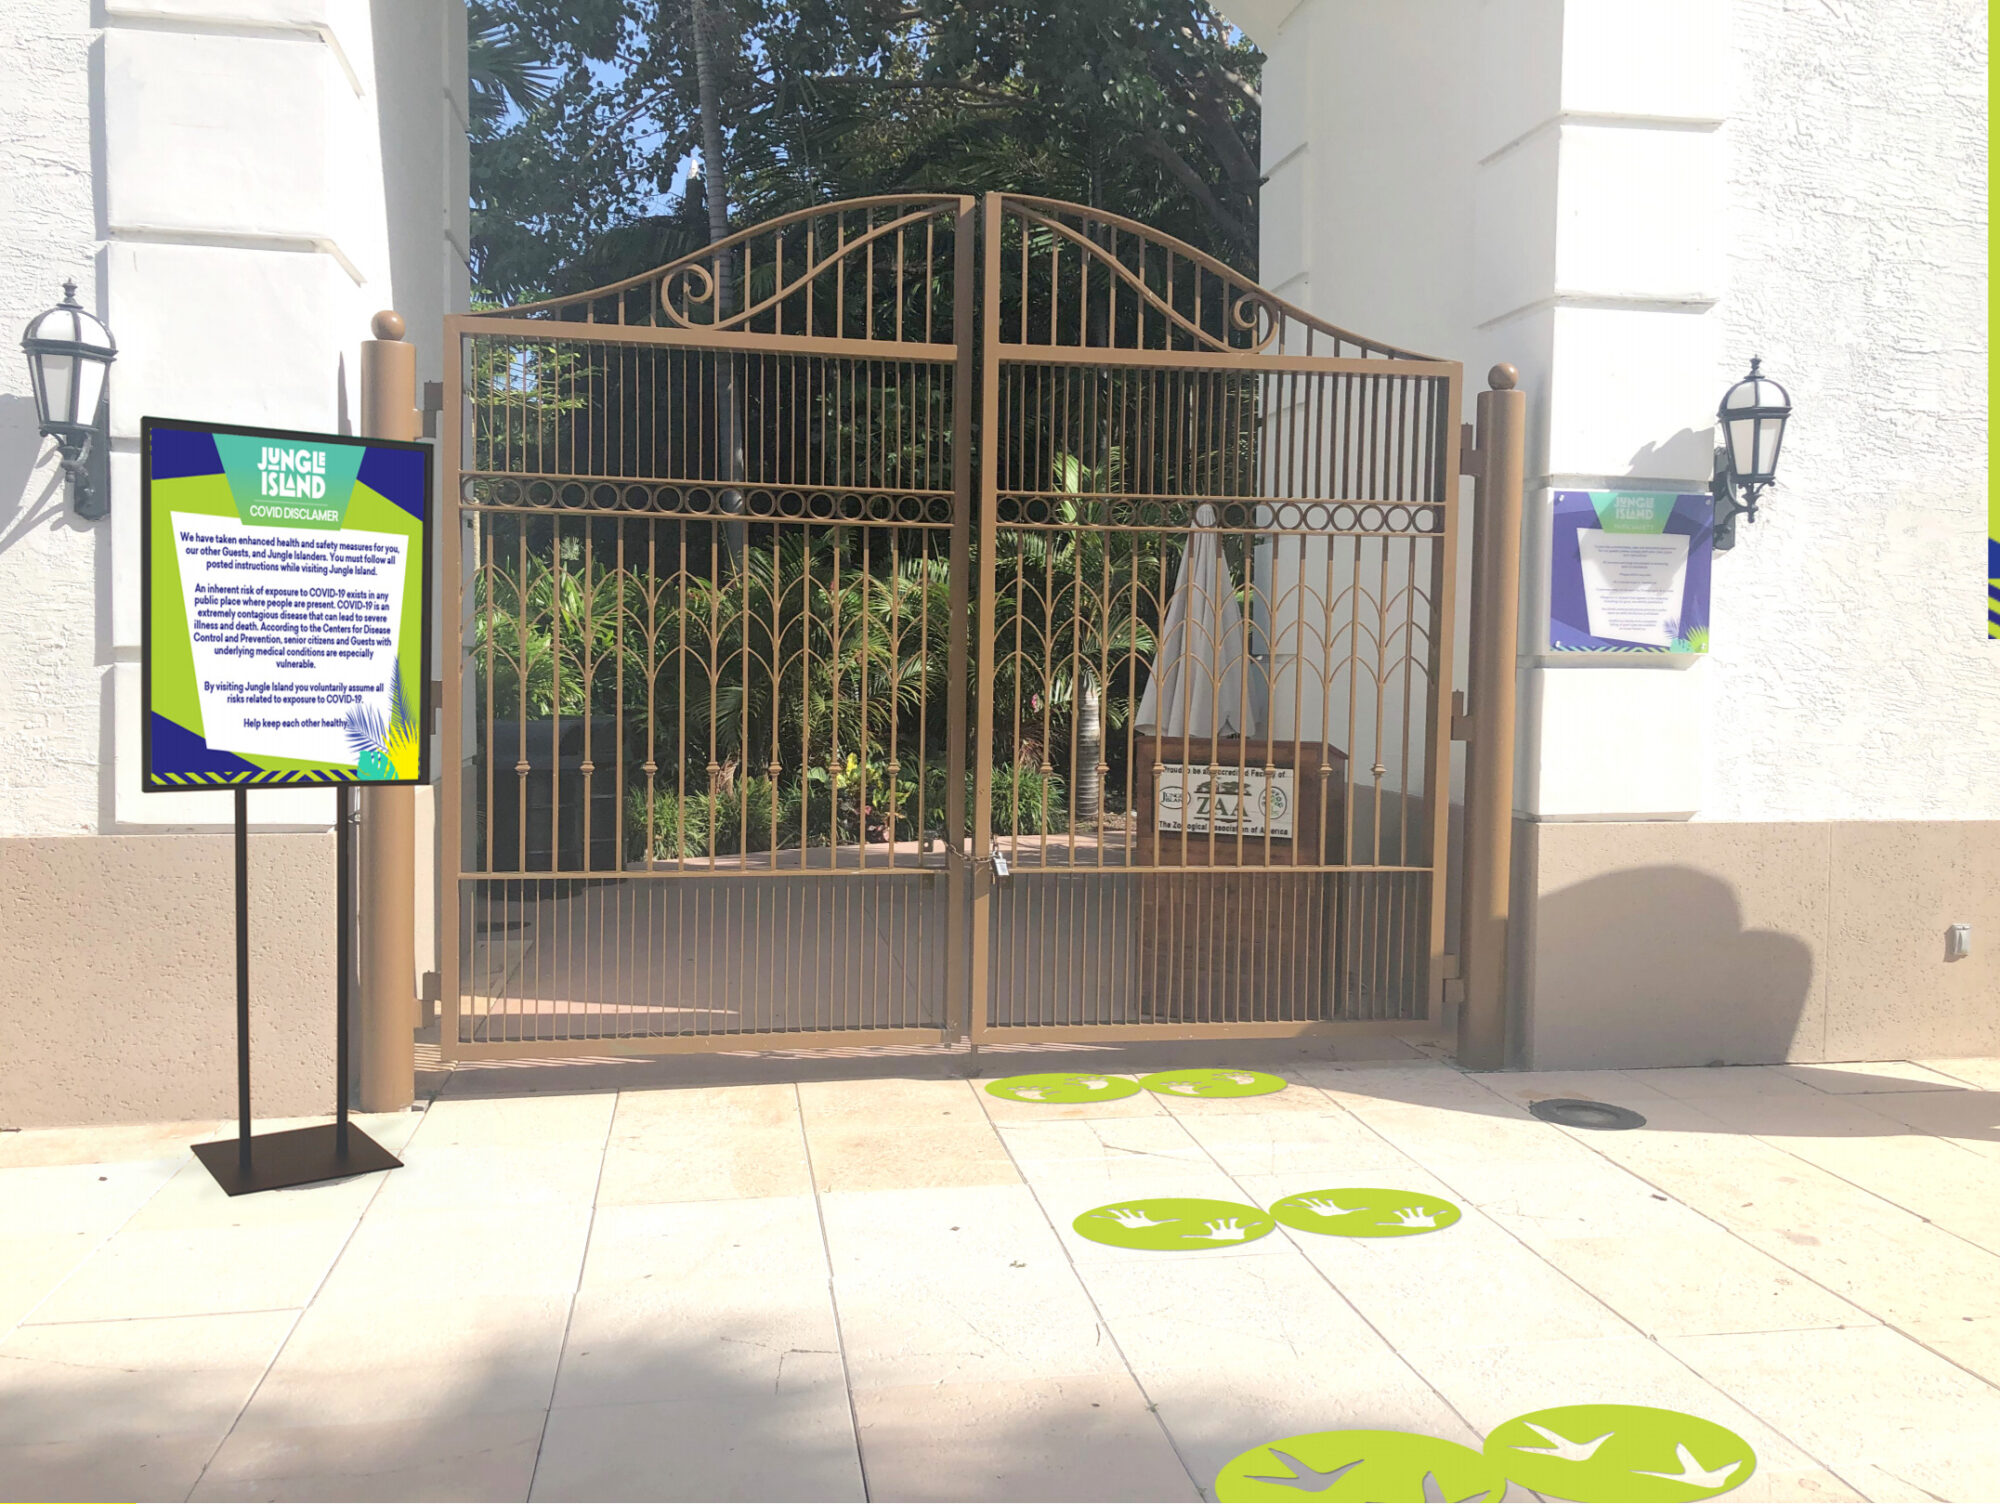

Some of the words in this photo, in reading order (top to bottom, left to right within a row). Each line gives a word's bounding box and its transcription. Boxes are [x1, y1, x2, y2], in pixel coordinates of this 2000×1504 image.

[257, 446, 326, 474] JUNGLE
[261, 471, 326, 499] ISLAND
[249, 505, 283, 518] COVID
[283, 507, 339, 521] DISCLAMER
[1616, 508, 1654, 520] ISLAND
[180, 532, 194, 542] We
[195, 533, 214, 543] have
[214, 534, 237, 544] taken
[238, 536, 275, 546] enhanced
[276, 537, 300, 547] health
[300, 539, 314, 548] and
[315, 540, 338, 552] safety
[373, 543, 384, 552] for
[384, 546, 400, 555] you,
[199, 546, 221, 555] other
[221, 547, 250, 558] Guests,
[251, 549, 266, 558] and
[267, 549, 293, 562] Jungle
[293, 551, 328, 561] Islanders.
[329, 551, 344, 562] You
[344, 555, 363, 563] must
[363, 554, 386, 564] follow
[386, 553, 395, 564] all
[205, 560, 233, 570] posted
[234, 560, 279, 571] instructions
[279, 561, 300, 572] while
[301, 563, 328, 576] visiting
[328, 565, 353, 577] Jungle
[354, 566, 378, 575] Island.
[194, 583, 206, 592] An
[207, 584, 239, 594] inherent
[240, 585, 254, 594] risk
[255, 586, 264, 595] of
[264, 589, 299, 600] exposure
[299, 589, 308, 597] to
[308, 588, 345, 598] COVID-19
[346, 590, 367, 599] exists
[368, 590, 375, 599] in
[376, 593, 388, 602] any
[194, 595, 218, 607] public
[219, 596, 241, 610] place
[242, 597, 265, 606] where
[266, 597, 292, 611] people
[306, 601, 335, 612] present.
[336, 600, 373, 610] COVID-19
[373, 602, 380, 610] is
[197, 609, 236, 622] extremely
[236, 608, 278, 623] contagious
[279, 610, 307, 620] disease
[308, 611, 323, 620] that
[338, 612, 354, 621] lead
[354, 614, 363, 622] to
[193, 620, 218, 630] illness
[219, 620, 234, 630] and
[235, 621, 258, 630] death.
[260, 622, 299, 635] According
[299, 624, 308, 632] to
[309, 624, 321, 632] the
[322, 624, 351, 633] Centers
[351, 624, 362, 633] for
[363, 625, 391, 634] Disease
[193, 632, 223, 642] Control
[224, 634, 239, 642] and
[239, 633, 282, 644] Prevention,
[283, 634, 306, 644] senior
[307, 636, 335, 645] citizens
[335, 637, 349, 645] and
[350, 636, 375, 646] Guests
[375, 637, 391, 646] with
[214, 646, 255, 658] underlying
[255, 647, 285, 656] medical
[286, 647, 325, 656] conditions
[338, 649, 374, 660] especially
[275, 659, 316, 668] vulnerable.
[203, 681, 214, 693] By
[215, 681, 244, 694] visiting
[244, 682, 270, 694] Jungle
[271, 682, 294, 691] Island
[294, 685, 308, 694] you
[309, 683, 347, 695] voluntarily
[375, 683, 384, 692] all
[226, 693, 244, 703] risks
[245, 693, 272, 703] related
[273, 695, 282, 703] to
[282, 697, 316, 706] exposure
[243, 718, 261, 730] Help
[262, 718, 281, 730] keep
[281, 719, 299, 727] each
[300, 718, 320, 727] other
[1196, 797, 1248, 817] ZAA
[1159, 820, 1171, 828] The
[1250, 826, 1258, 834] of
[1260, 826, 1288, 836] Aerica
